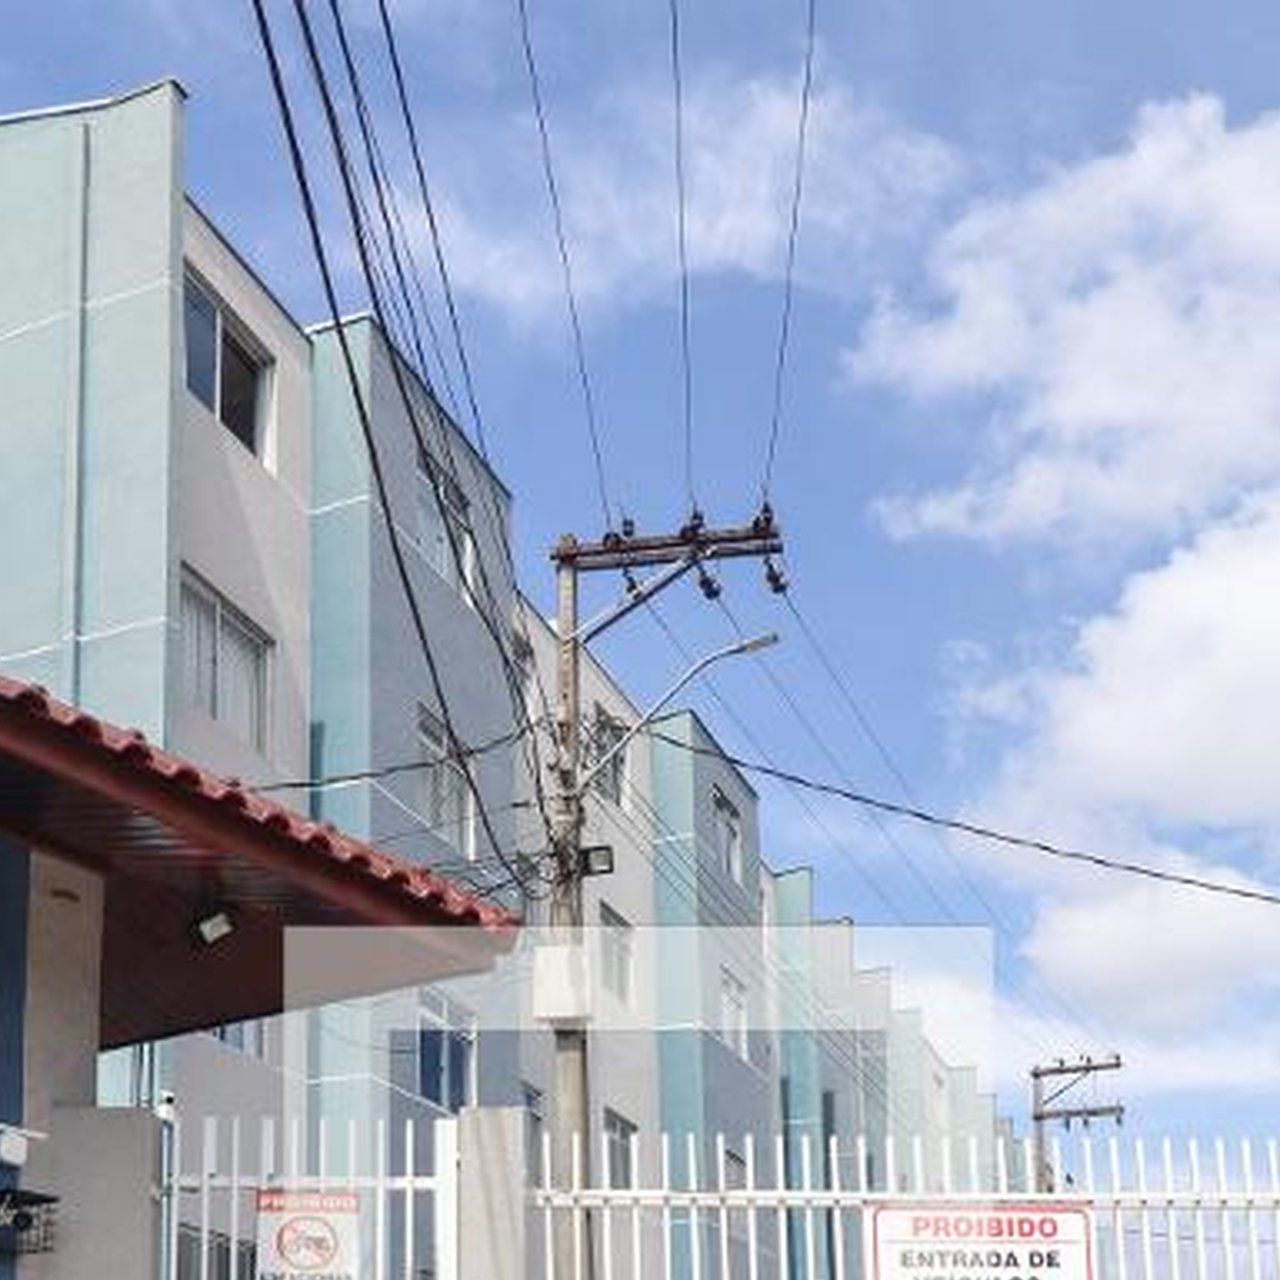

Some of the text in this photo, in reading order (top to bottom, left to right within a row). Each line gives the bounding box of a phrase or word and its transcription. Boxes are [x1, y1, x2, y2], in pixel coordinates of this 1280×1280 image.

[912, 1217, 1058, 1237] PROIBIDO
[901, 1250, 1061, 1268] ENTRADA DE
